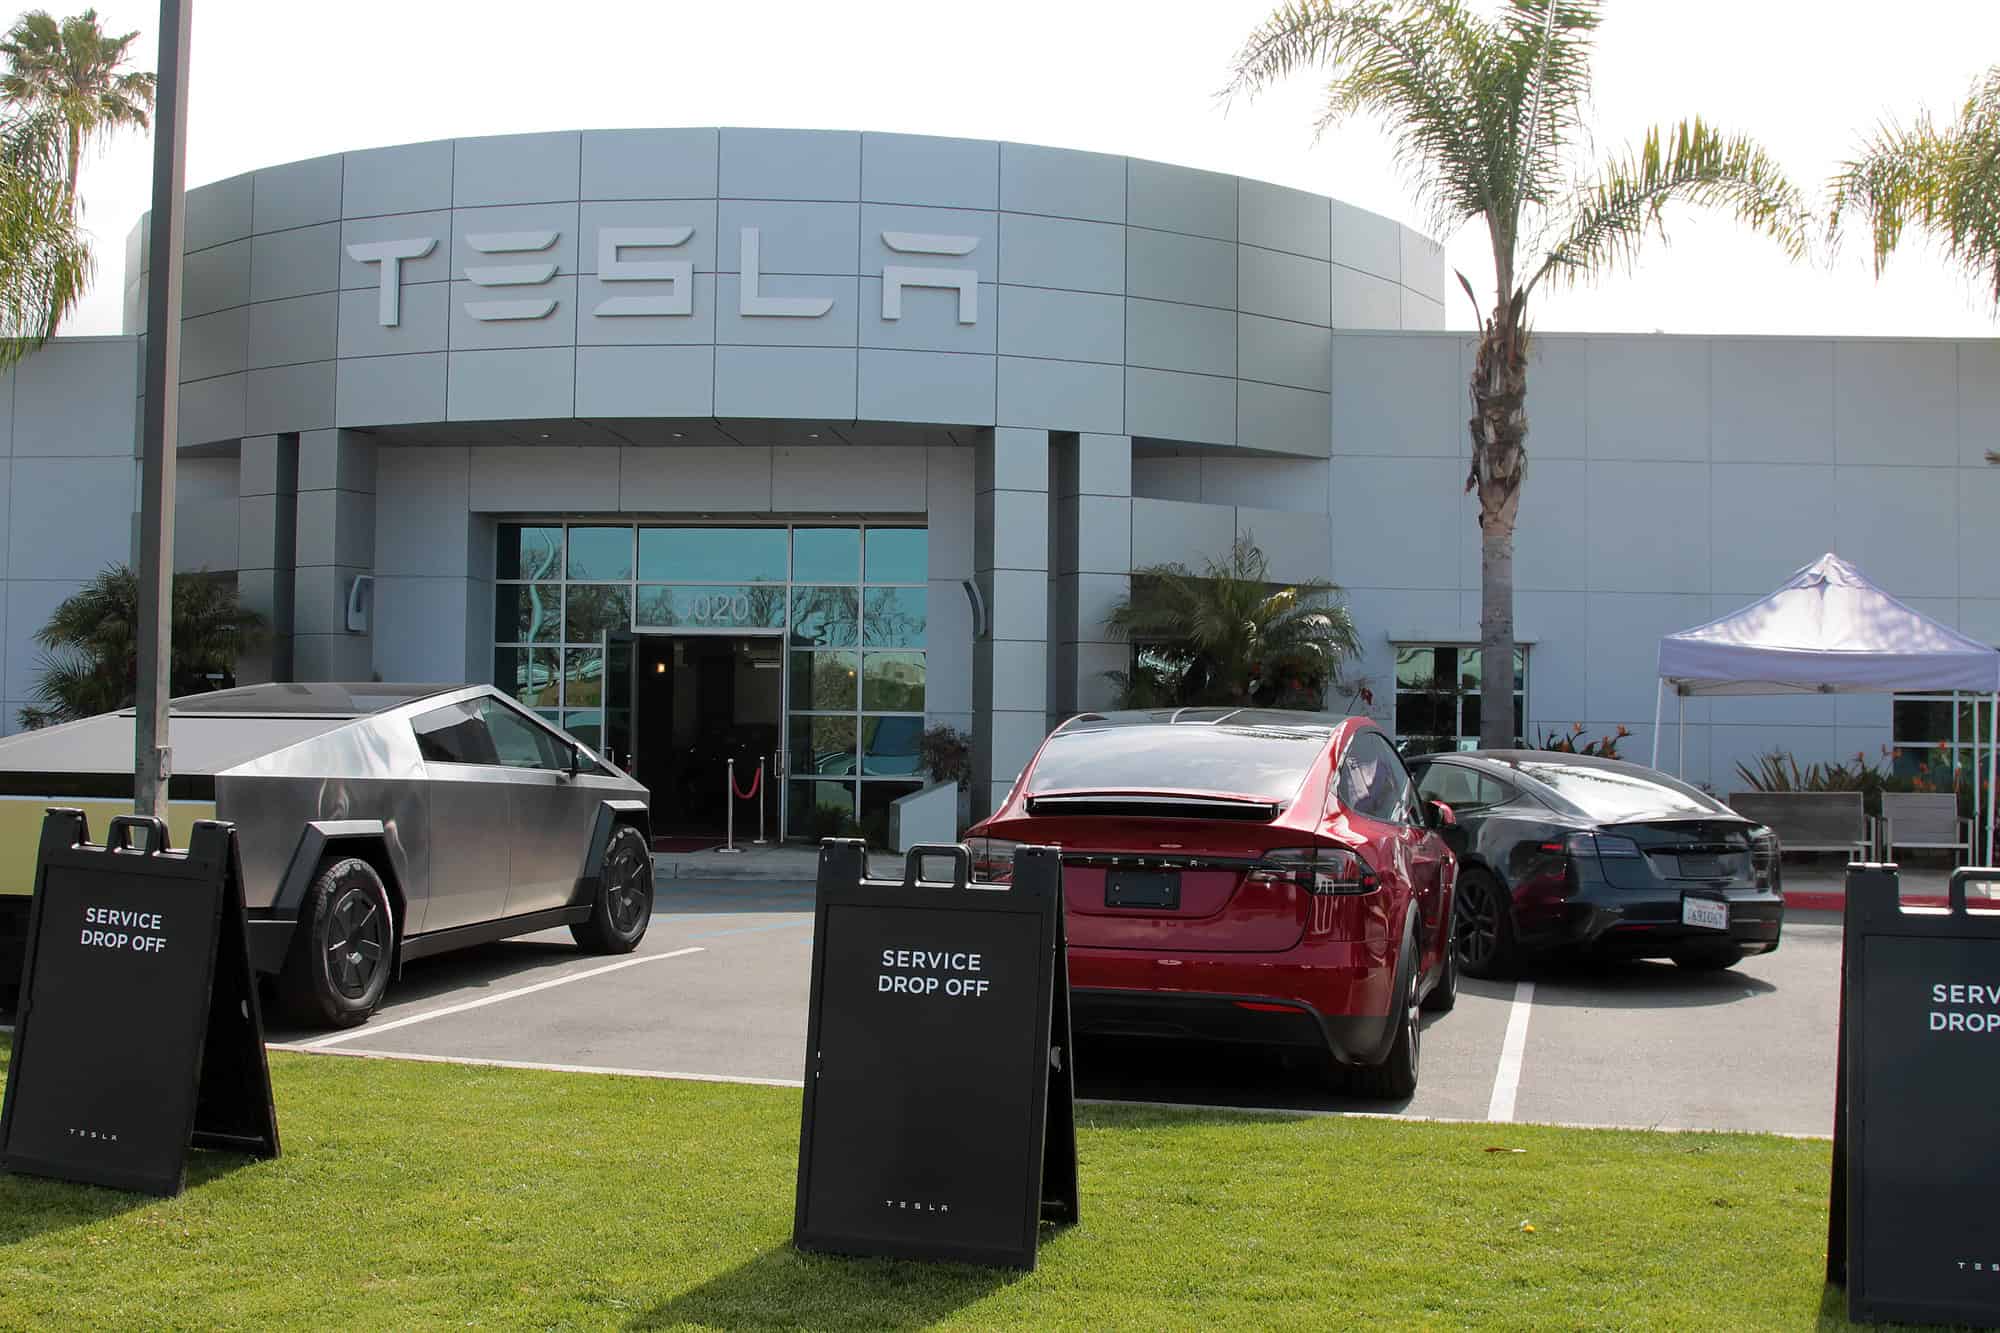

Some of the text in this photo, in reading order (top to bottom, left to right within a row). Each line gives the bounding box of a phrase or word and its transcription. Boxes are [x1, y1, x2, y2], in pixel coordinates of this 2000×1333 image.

[346, 226, 980, 326] TESLA
[1085, 856, 1198, 867] TESLA
[85, 907, 162, 930] SERVICE
[81, 929, 167, 953] DROP OFF
[882, 949, 981, 971] SERVICE
[878, 974, 990, 997] DROP OFF
[1929, 1012, 2000, 1033] DROP
[69, 1128, 118, 1141] TESLA
[885, 1200, 950, 1212] TESLA
